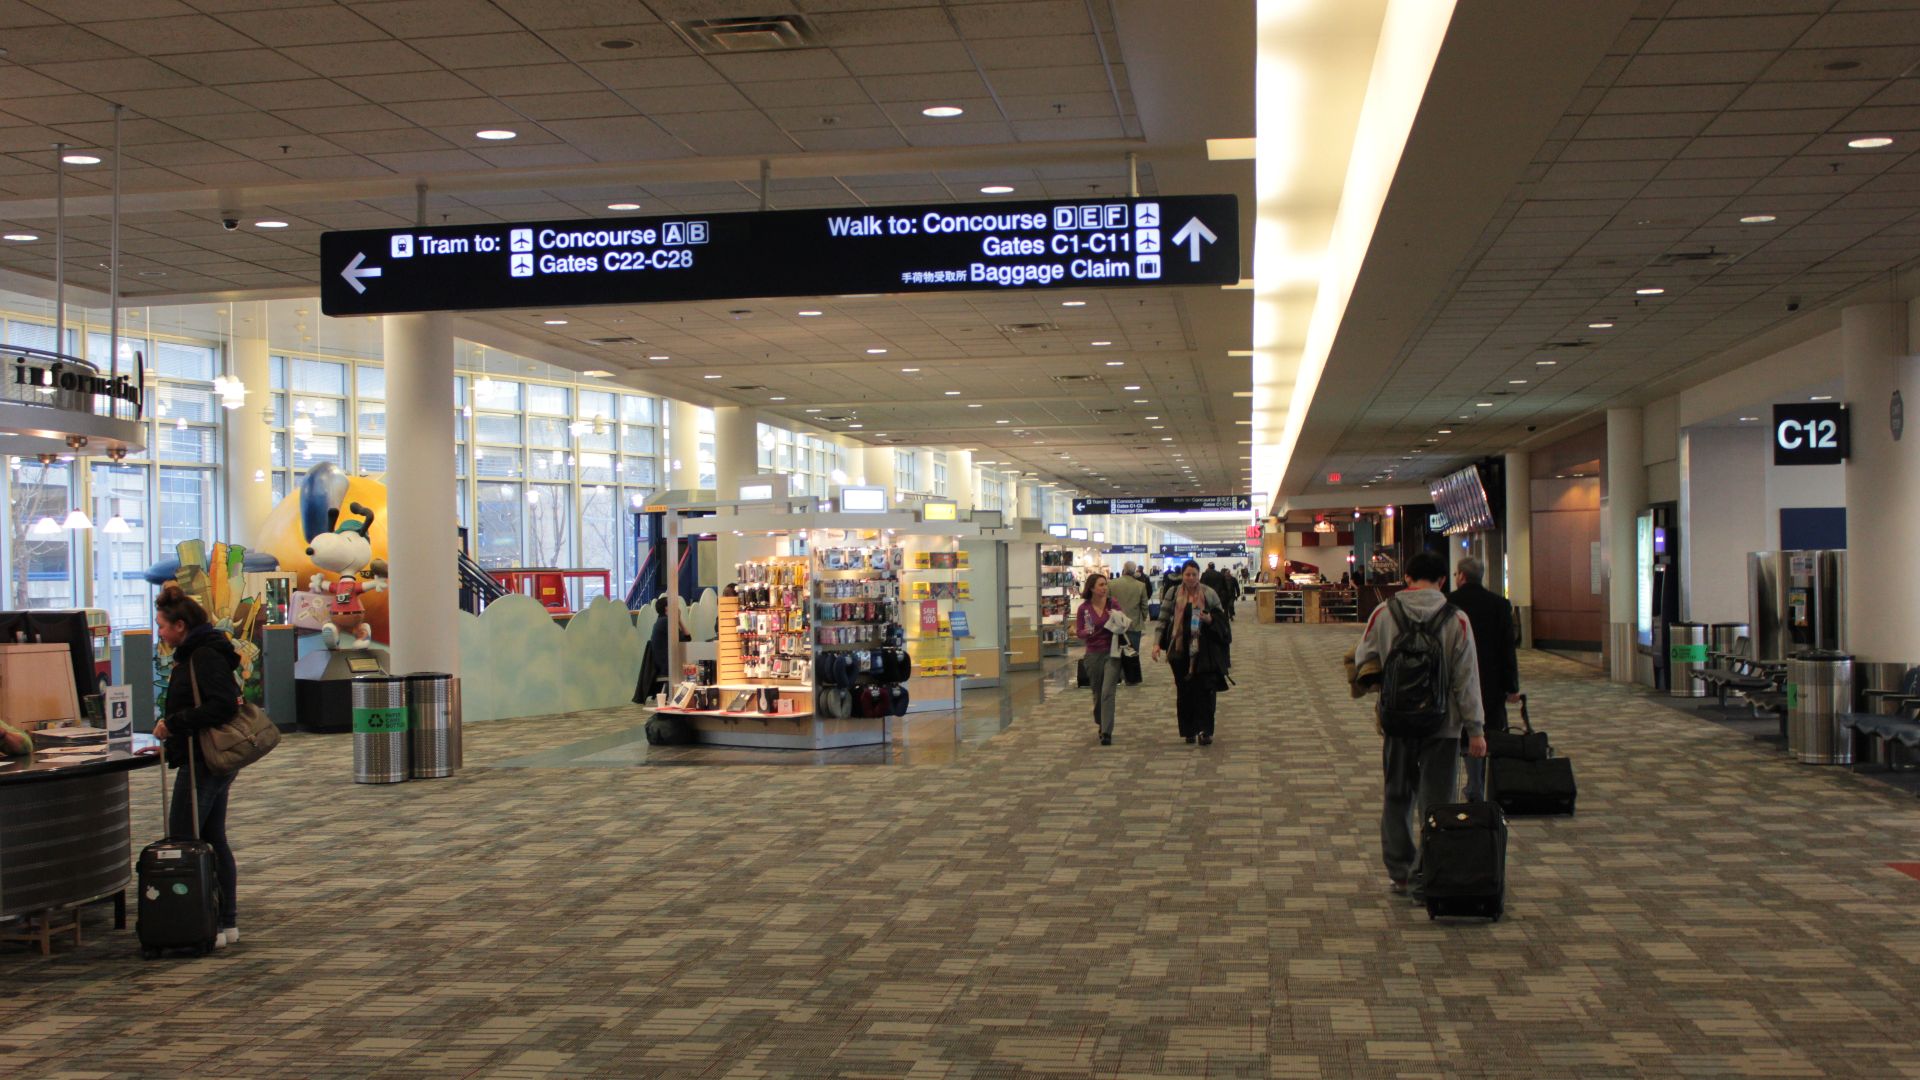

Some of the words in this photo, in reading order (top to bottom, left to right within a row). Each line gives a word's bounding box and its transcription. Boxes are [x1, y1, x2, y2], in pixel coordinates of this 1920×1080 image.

[828, 215, 883, 237] Walk
[887, 215, 917, 235] to:
[922, 212, 1047, 234] Concourse
[1057, 207, 1076, 229] D
[1082, 206, 1101, 228] E
[1107, 205, 1124, 227] F
[418, 235, 469, 255] Tram
[473, 234, 501, 252] to:
[538, 228, 657, 249] Concourse
[664, 222, 684, 245] A
[690, 222, 708, 244] B
[982, 235, 1046, 257] Gates
[1051, 232, 1130, 255] C1-C11
[539, 254, 599, 274] Gates
[603, 249, 693, 272] C22-C28
[970, 262, 1065, 286] Baggage
[1070, 258, 1130, 279] Claim
[901, 270, 968, 284] 手荷物受取所
[1777, 419, 1837, 450] C12
